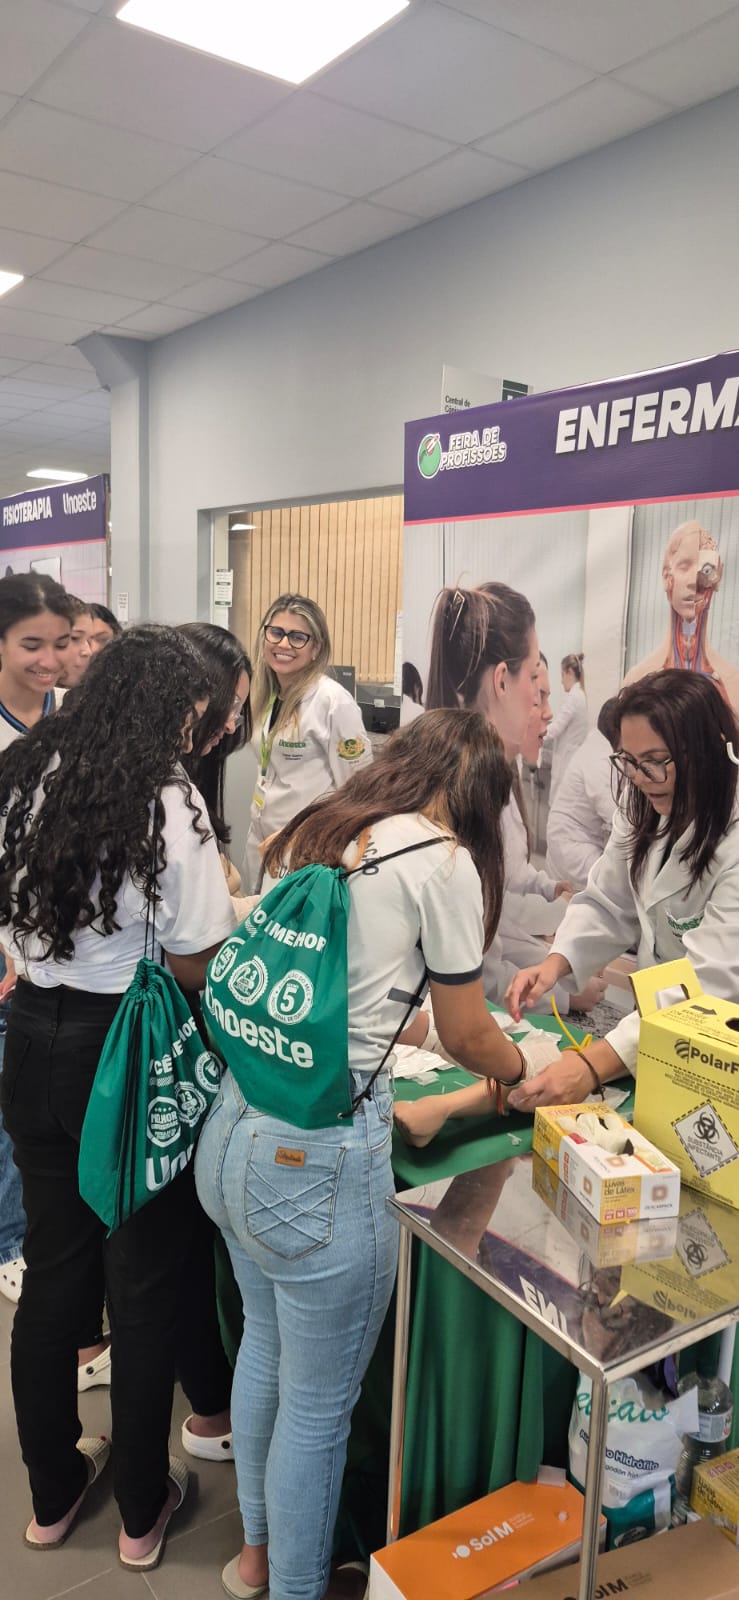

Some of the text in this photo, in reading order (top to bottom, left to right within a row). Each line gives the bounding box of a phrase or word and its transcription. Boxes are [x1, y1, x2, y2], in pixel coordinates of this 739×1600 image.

[556, 376, 739, 454] ENFERM
[450, 427, 500, 451] FEIRA DE
[3, 496, 52, 527] FISIOTERAPIA
[62, 487, 97, 515] Unoeste
[614, 1450, 660, 1471] Hidrófilo
